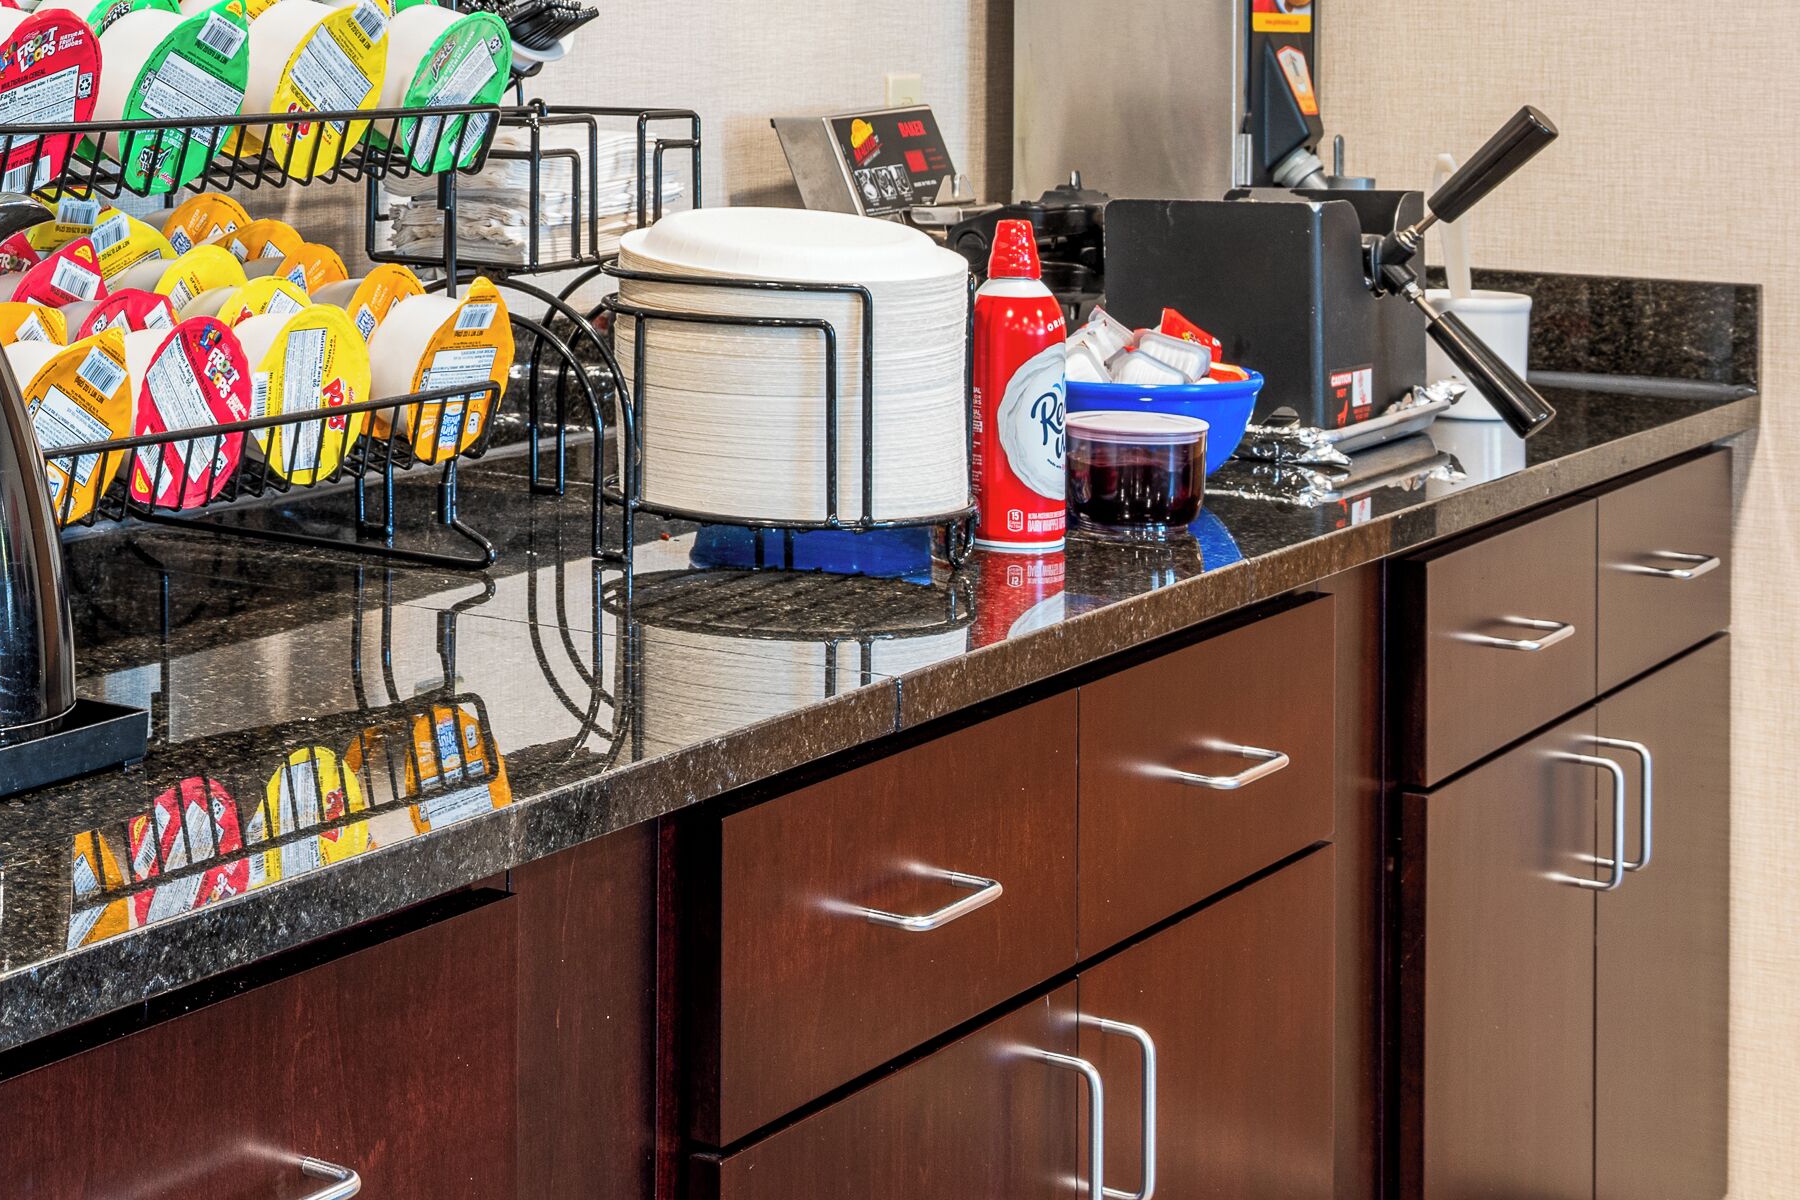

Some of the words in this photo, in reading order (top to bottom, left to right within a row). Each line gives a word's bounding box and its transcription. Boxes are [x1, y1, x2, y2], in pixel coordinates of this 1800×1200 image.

[60, 29, 85, 40] NATURAL
[60, 36, 75, 45] FRUIT
[17, 26, 58, 62] FROOT
[59, 39, 83, 51] FLAVORS
[20, 41, 56, 73] LOOPS
[0, 90, 17, 100] Facts
[897, 120, 927, 138] BAKER
[175, 335, 186, 363] Nutrition
[185, 363, 194, 383] Facts
[207, 347, 241, 387] FROOT
[203, 363, 231, 399] LOOPS
[322, 377, 346, 431] POS
[1011, 511, 1019, 521] 15
[1028, 520, 1042, 532] DAIRY
